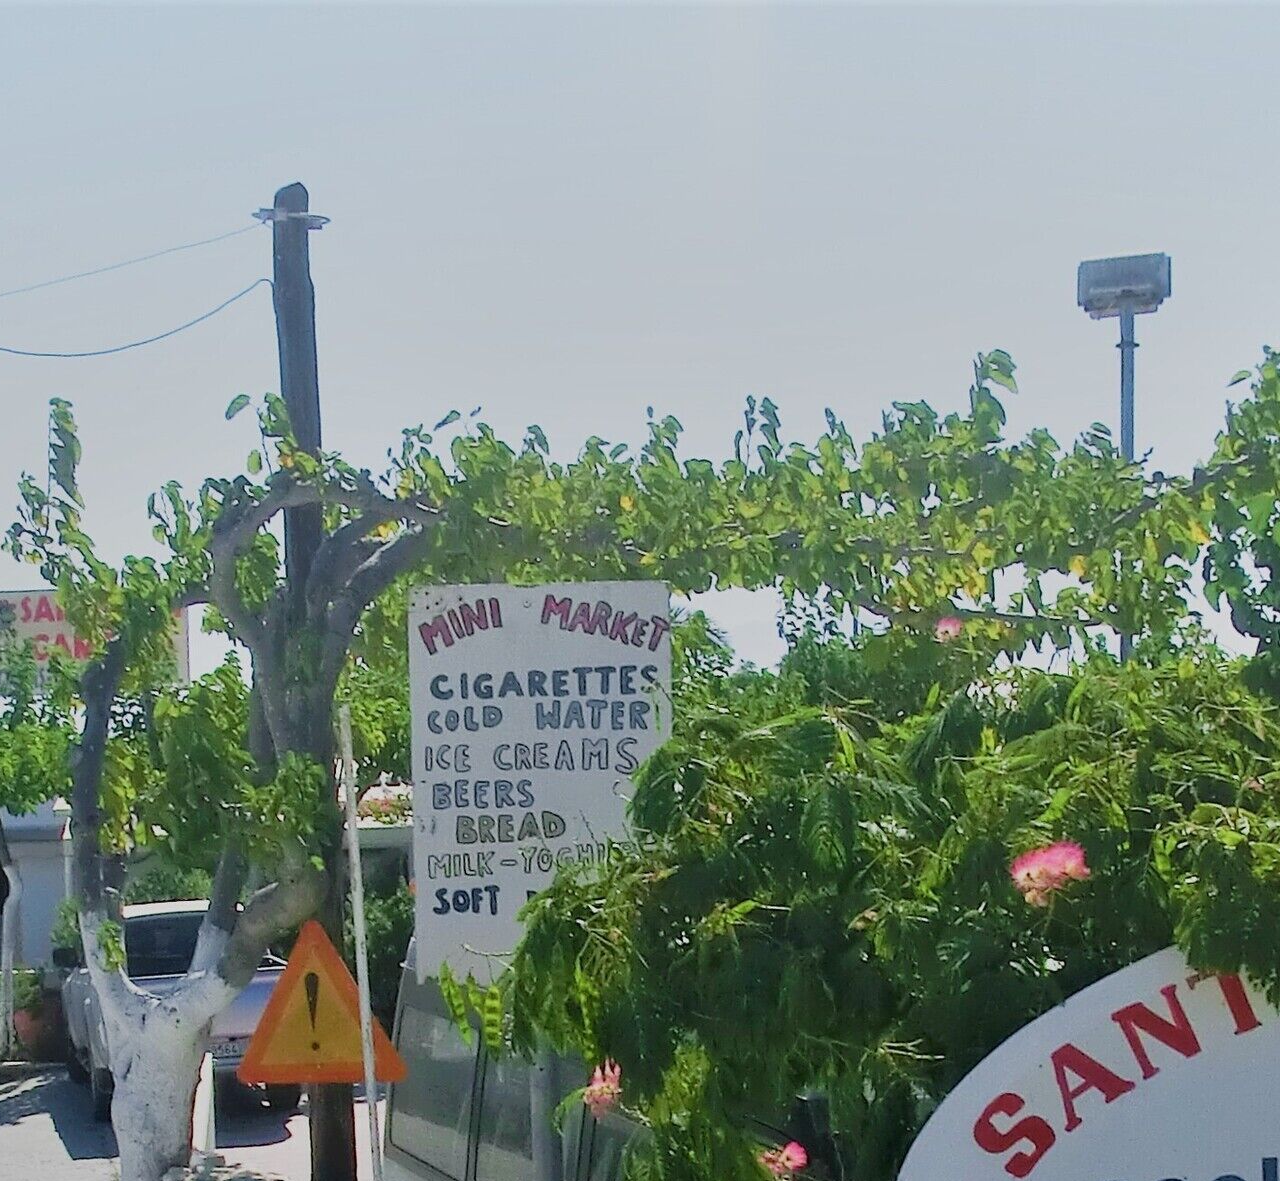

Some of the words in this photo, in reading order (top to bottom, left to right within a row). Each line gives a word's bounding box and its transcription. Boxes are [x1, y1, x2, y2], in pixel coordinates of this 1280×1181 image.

[419, 597, 504, 656] MINI
[540, 593, 670, 653] MARKET
[430, 664, 660, 701] CIGARETTES
[427, 704, 503, 735] COLD
[535, 699, 650, 731] WATER
[424, 743, 472, 773] ICE
[492, 736, 640, 776] CREAMS
[431, 778, 536, 810] BEERS
[455, 812, 567, 845] BREAD
[433, 884, 501, 916] SOFT
